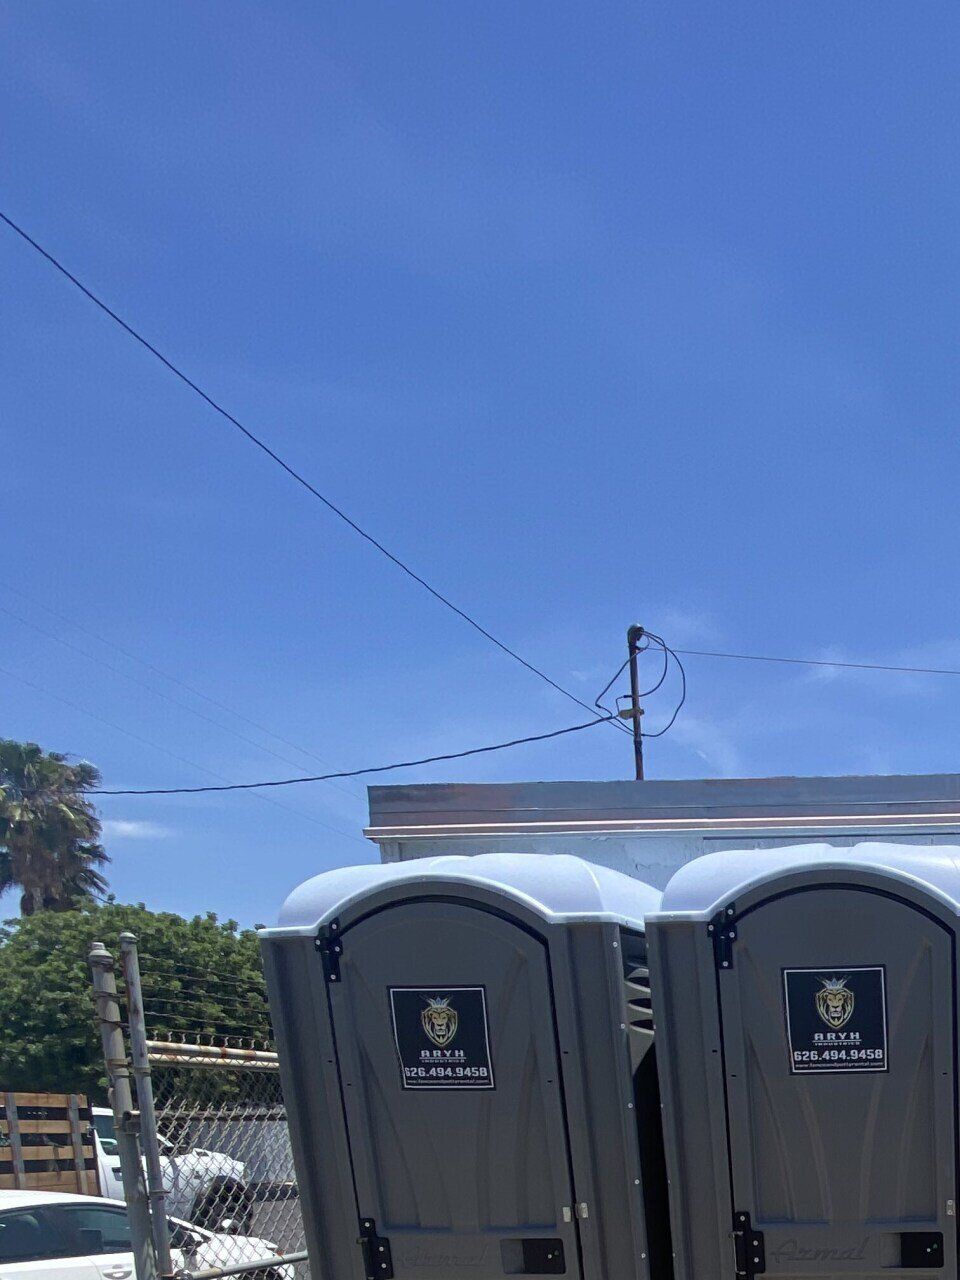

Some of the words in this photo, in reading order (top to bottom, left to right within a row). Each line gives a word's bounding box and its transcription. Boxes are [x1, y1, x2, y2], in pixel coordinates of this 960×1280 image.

[814, 1032, 860, 1041] ARYH
[420, 1049, 465, 1058] ARYH
[794, 1049, 883, 1061] 626.494.9458
[404, 1067, 488, 1077] 626.494.9458
